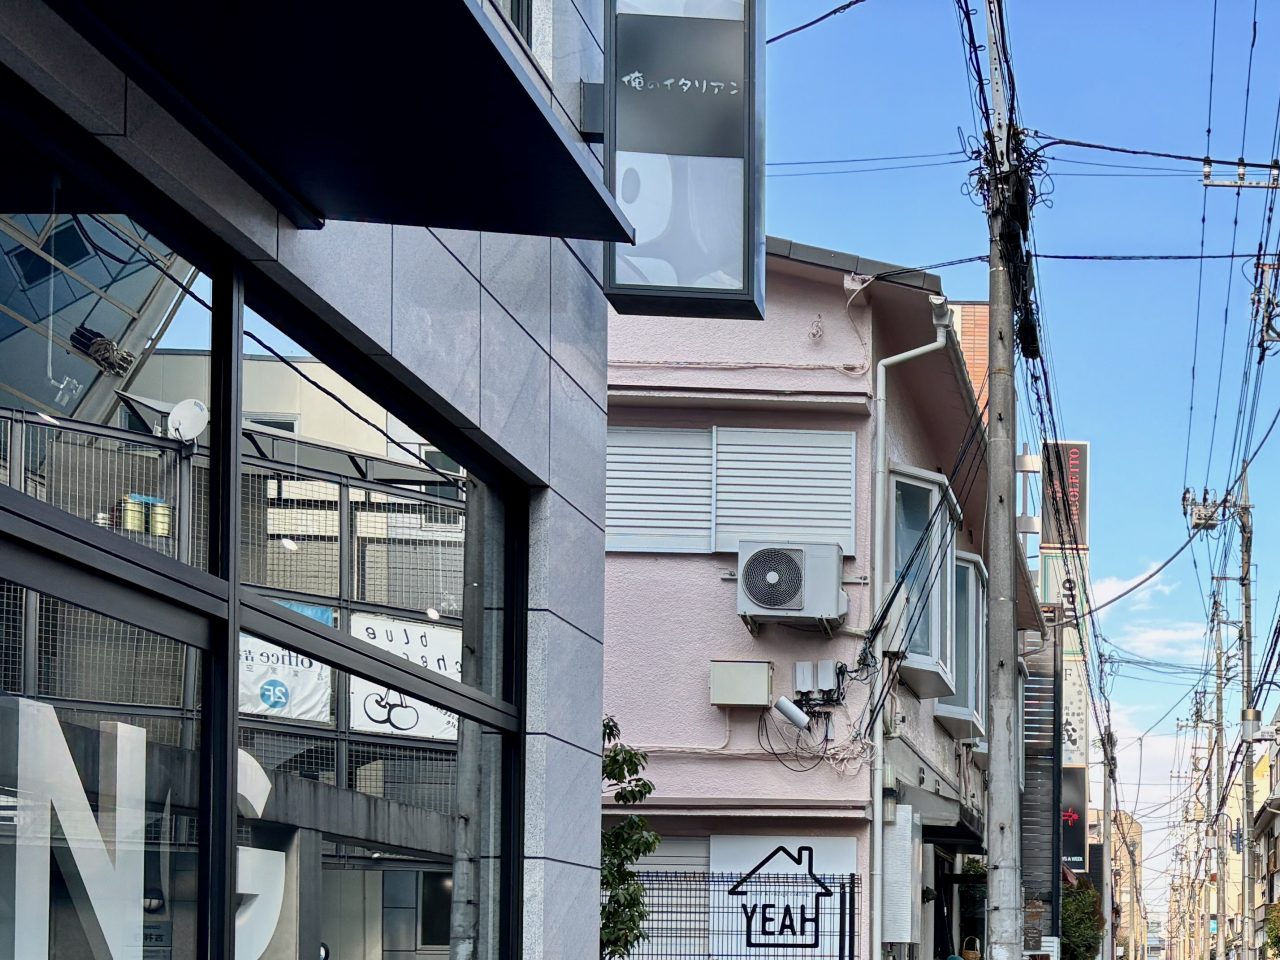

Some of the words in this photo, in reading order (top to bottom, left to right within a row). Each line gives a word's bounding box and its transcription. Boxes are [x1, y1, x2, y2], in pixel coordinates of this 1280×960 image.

[621, 71, 738, 95] 俺のイタリアン
[741, 903, 818, 937] YEAH
